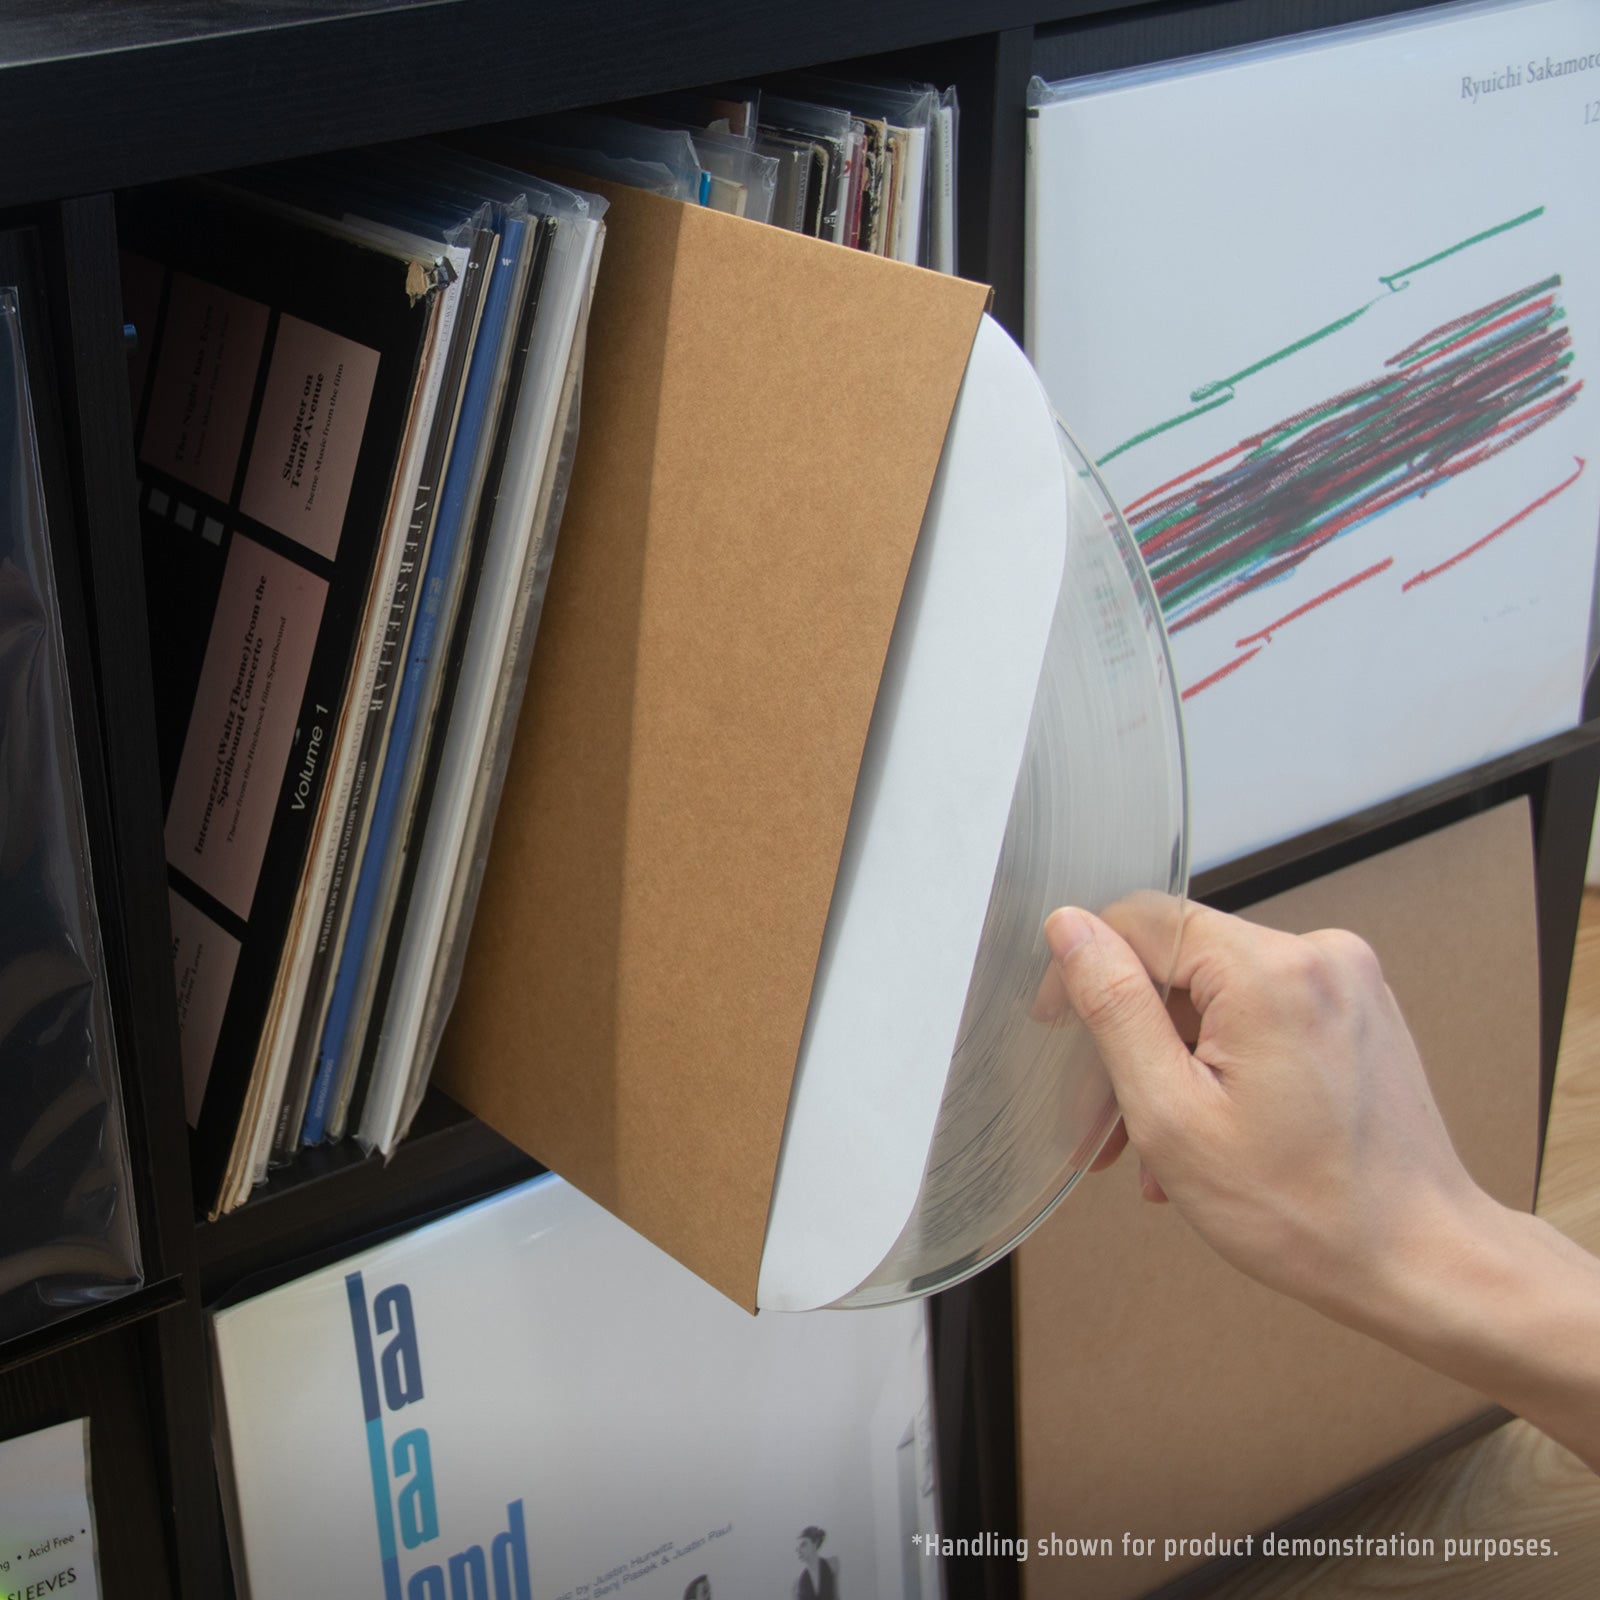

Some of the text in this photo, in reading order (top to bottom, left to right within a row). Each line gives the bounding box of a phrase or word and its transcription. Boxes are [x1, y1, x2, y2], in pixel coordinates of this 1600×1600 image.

[1461, 65, 1522, 104] Ryuichi
[1584, 99, 1600, 125] 12
[281, 373, 313, 480] Slaughter on
[290, 372, 325, 489] Tenth Avenue
[304, 362, 344, 511] Theme Music from the film
[369, 485, 431, 711] INTERSTELLAR
[194, 573, 267, 854] Intermezzo (Waltz Theme) from the
[218, 636, 263, 807] Spellbound Concerto
[226, 616, 286, 843] Theme from the Hitchcock film Spellbound
[289, 702, 329, 812] Volume 1
[317, 760, 368, 953] ORIGINAL MOTION PICTURE SOUNDTRACK
[344, 1270, 424, 1423] la
[28, 1540, 51, 1560] Acid
[53, 1534, 75, 1549] Free
[366, 1416, 439, 1561] la
[708, 1523, 732, 1542] Paul
[594, 1564, 628, 1586] Justin
[630, 1541, 674, 1568] Hurwitz
